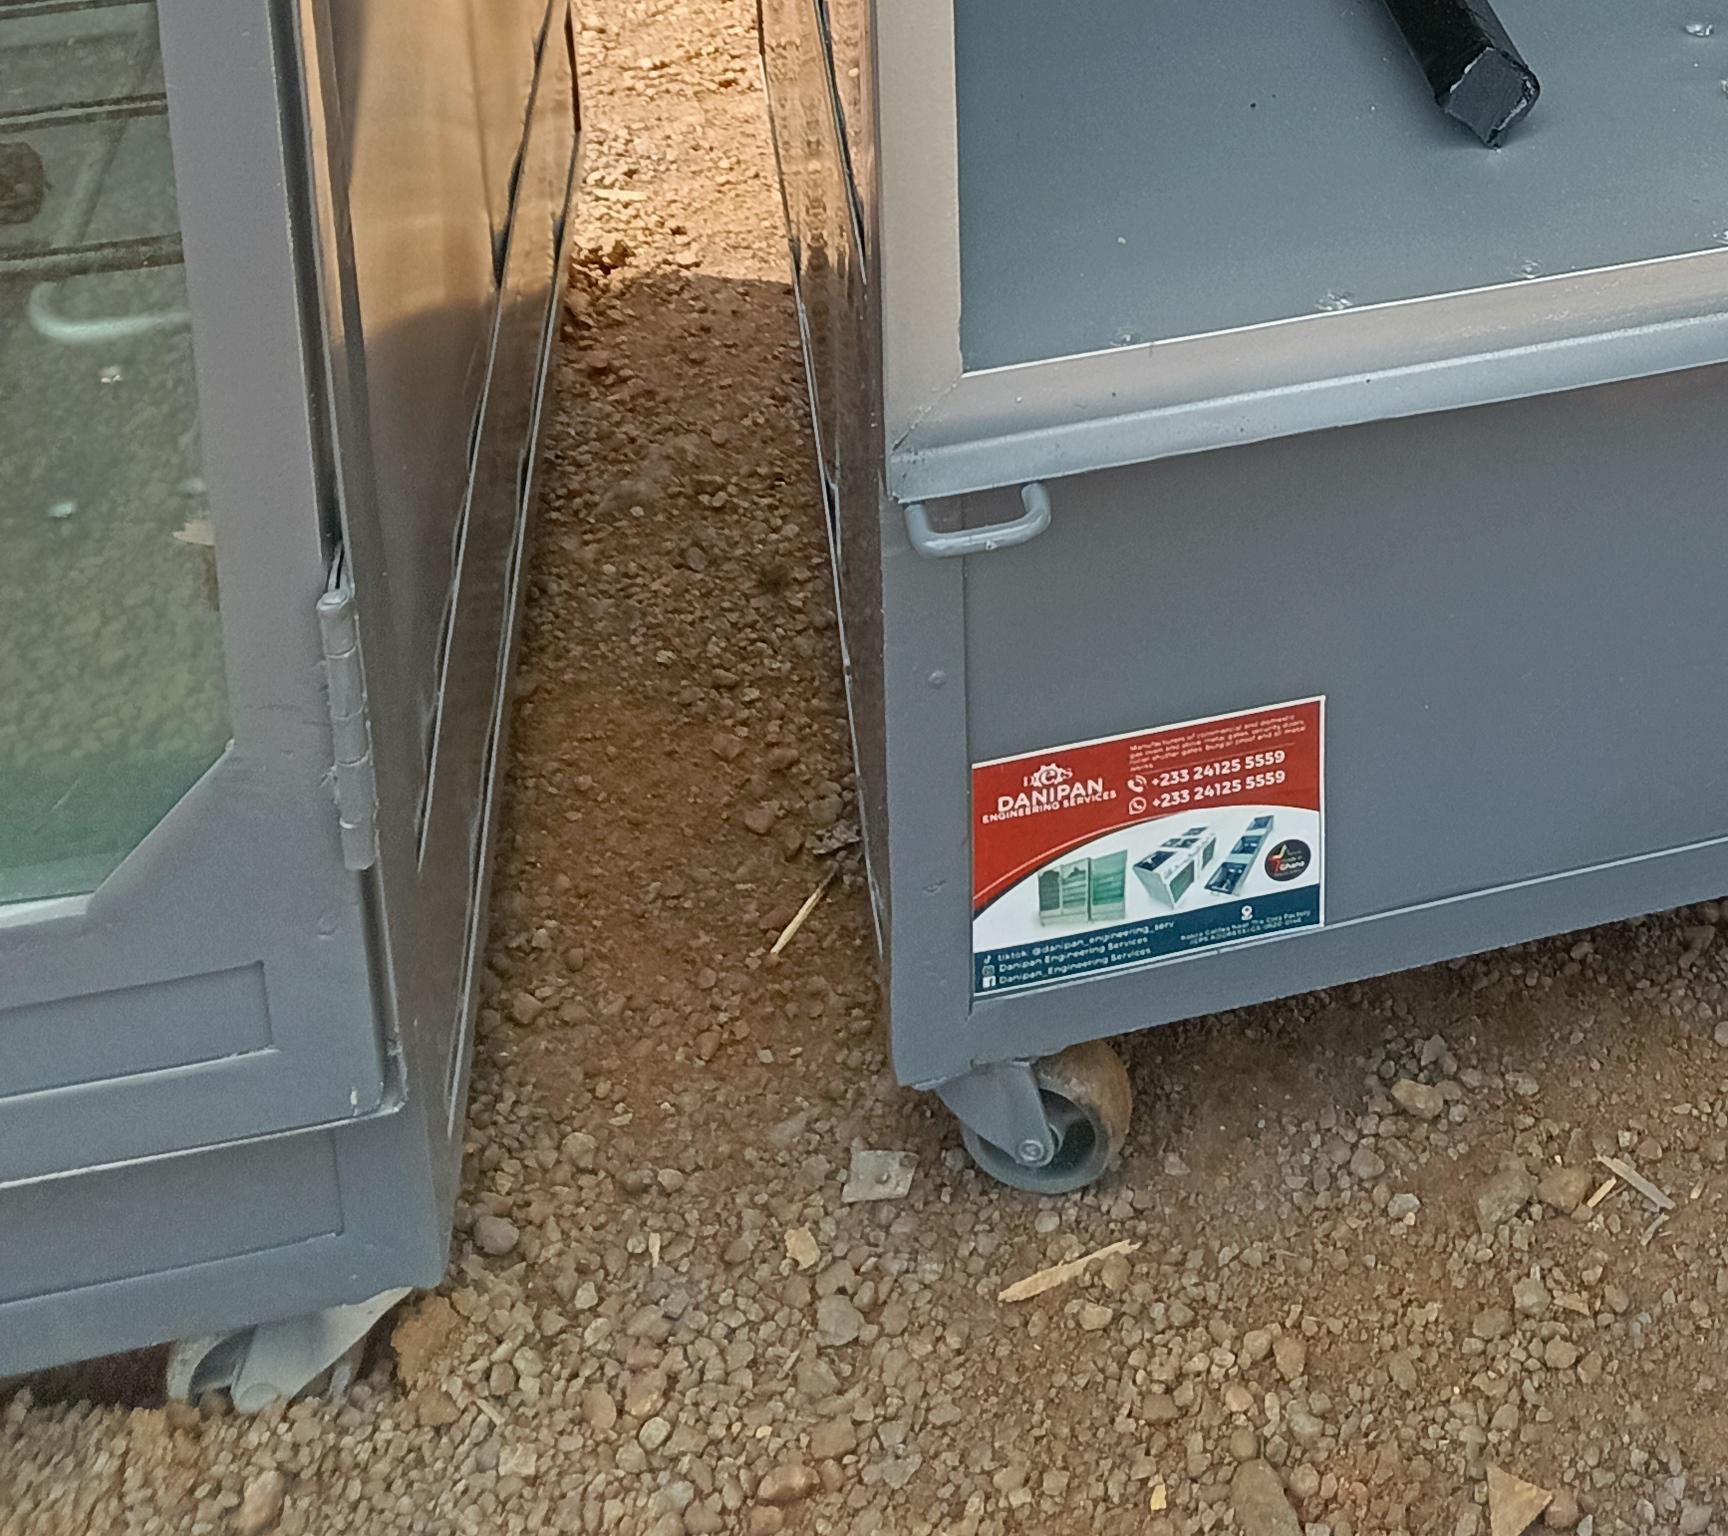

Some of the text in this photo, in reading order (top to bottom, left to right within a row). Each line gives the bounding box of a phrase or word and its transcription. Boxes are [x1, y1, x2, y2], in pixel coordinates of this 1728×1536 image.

[1152, 750, 1284, 787] +233 24125 5559
[982, 790, 1116, 823] ENGINEERING SERVICES
[997, 777, 1103, 811] DANIPAN
[1152, 770, 1285, 808] +233 24125 5559
